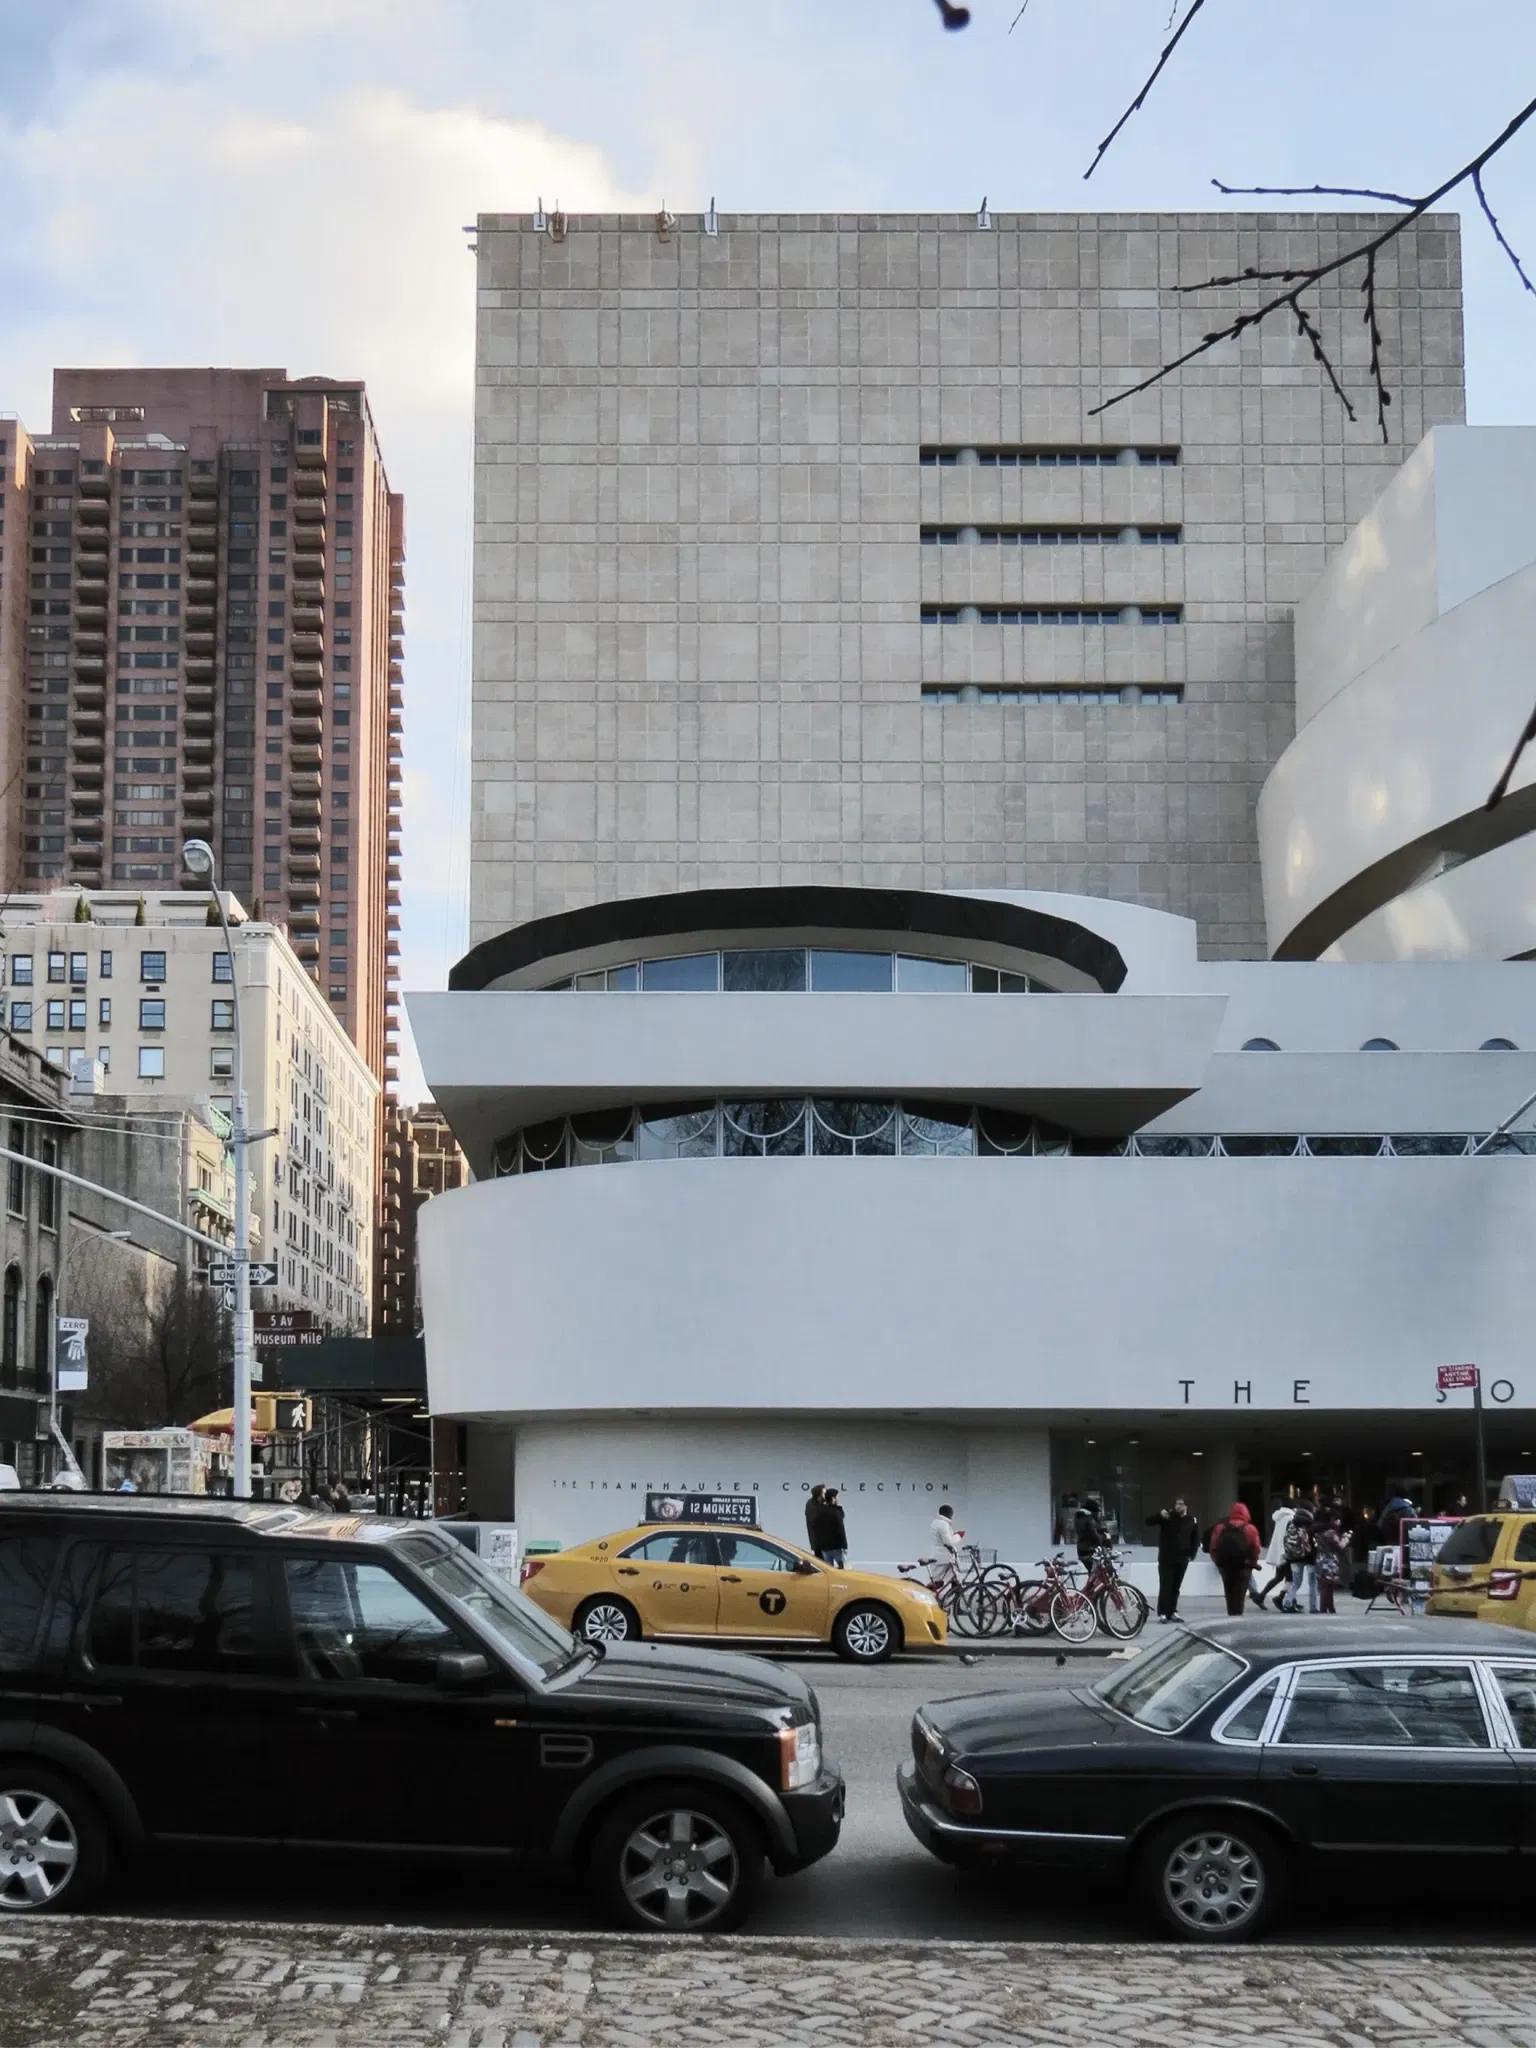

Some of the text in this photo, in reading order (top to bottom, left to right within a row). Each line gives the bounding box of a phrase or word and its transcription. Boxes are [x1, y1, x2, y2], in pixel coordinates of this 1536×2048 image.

[219, 1270, 236, 1280] ON
[63, 1321, 86, 1330] ZERO
[270, 1315, 293, 1327] 5 Av
[254, 1333, 322, 1345] Museum Mile
[1178, 1380, 1310, 1404] THE
[553, 1480, 949, 1492] THE THANNHAUSER COLECTION
[690, 1503, 751, 1515] 12 MONKEYS
